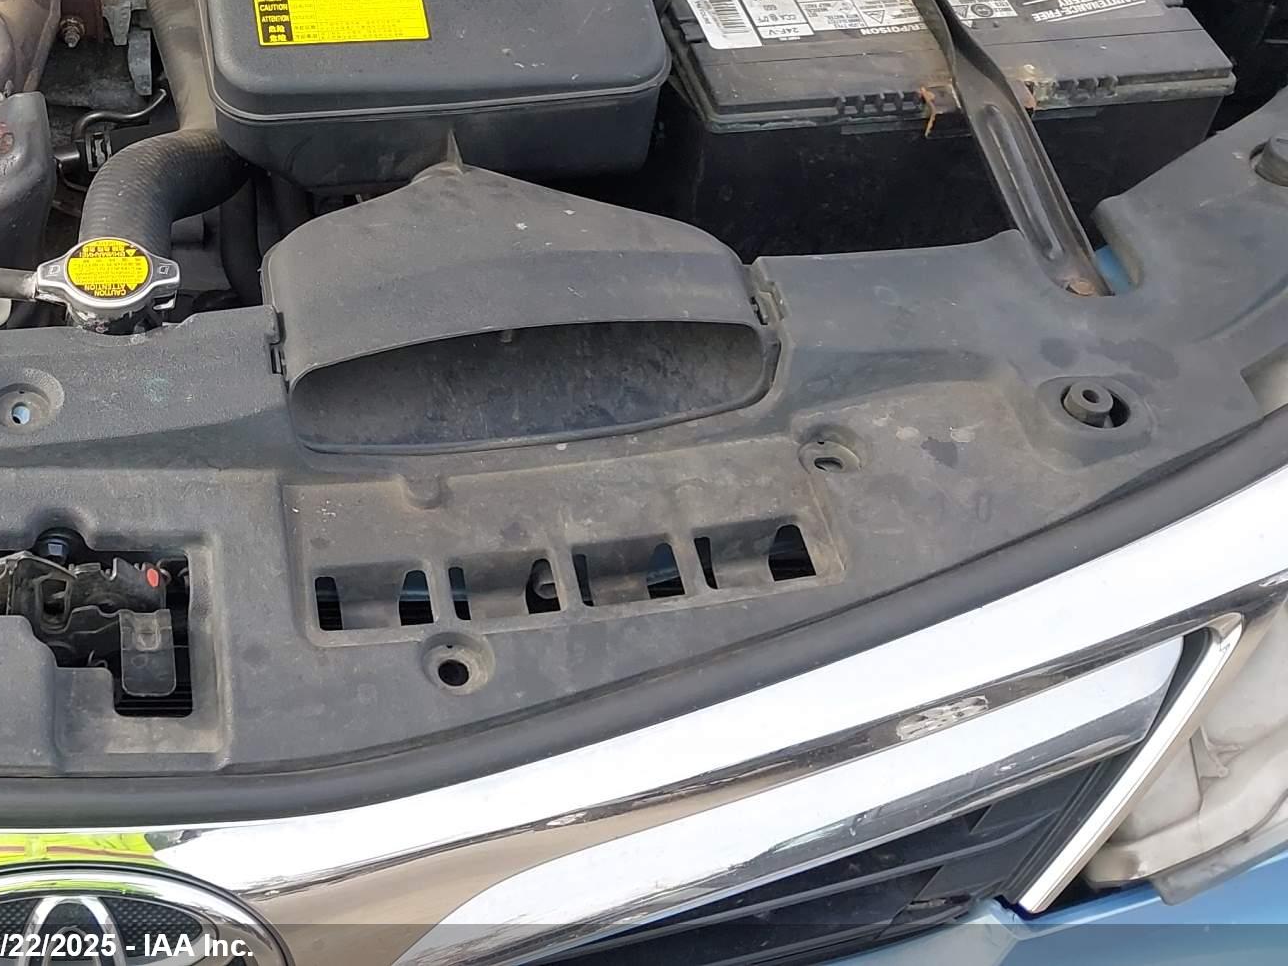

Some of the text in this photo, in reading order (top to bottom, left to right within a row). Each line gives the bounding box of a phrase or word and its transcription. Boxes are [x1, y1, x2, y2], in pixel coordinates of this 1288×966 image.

[259, 3, 289, 12] CAUTION
[84, 283, 126, 291] ATTENTION
[94, 289, 127, 297] CAUTION
